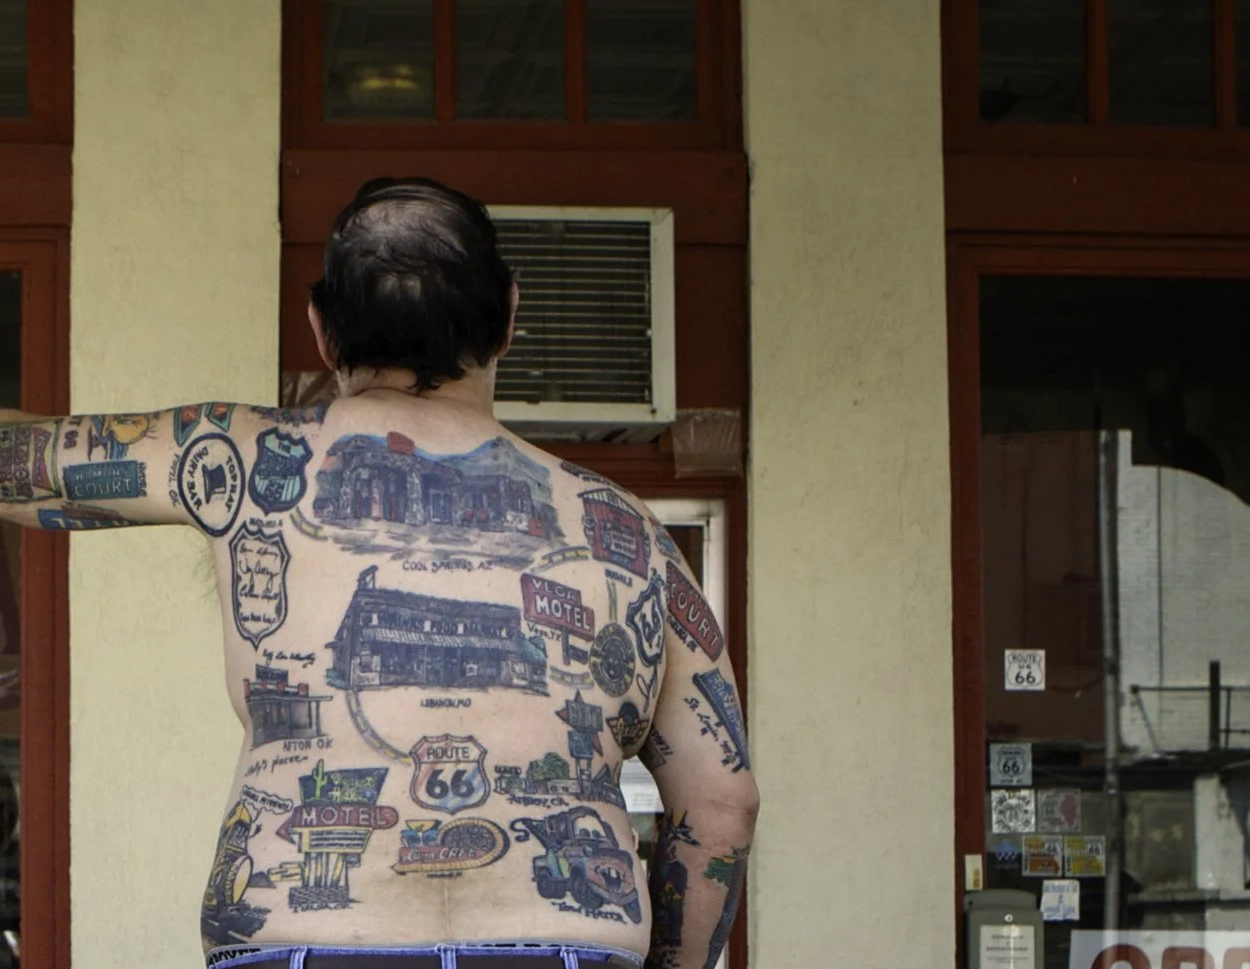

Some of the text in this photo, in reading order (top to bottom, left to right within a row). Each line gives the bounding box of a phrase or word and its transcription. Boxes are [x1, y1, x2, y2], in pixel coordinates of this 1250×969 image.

[74, 478, 132, 498] COURT
[187, 480, 203, 512] BAR
[402, 560, 428, 572] COOL
[532, 577, 576, 601] VEGA
[535, 595, 591, 630] MOTEL
[670, 583, 720, 647] COURT
[1011, 654, 1037, 663] ROUTE
[1015, 671, 1036, 684] 66
[427, 746, 470, 760] ROUTE
[1002, 760, 1020, 774] 66
[426, 768, 475, 799] 66
[301, 806, 387, 825] MOTEL
